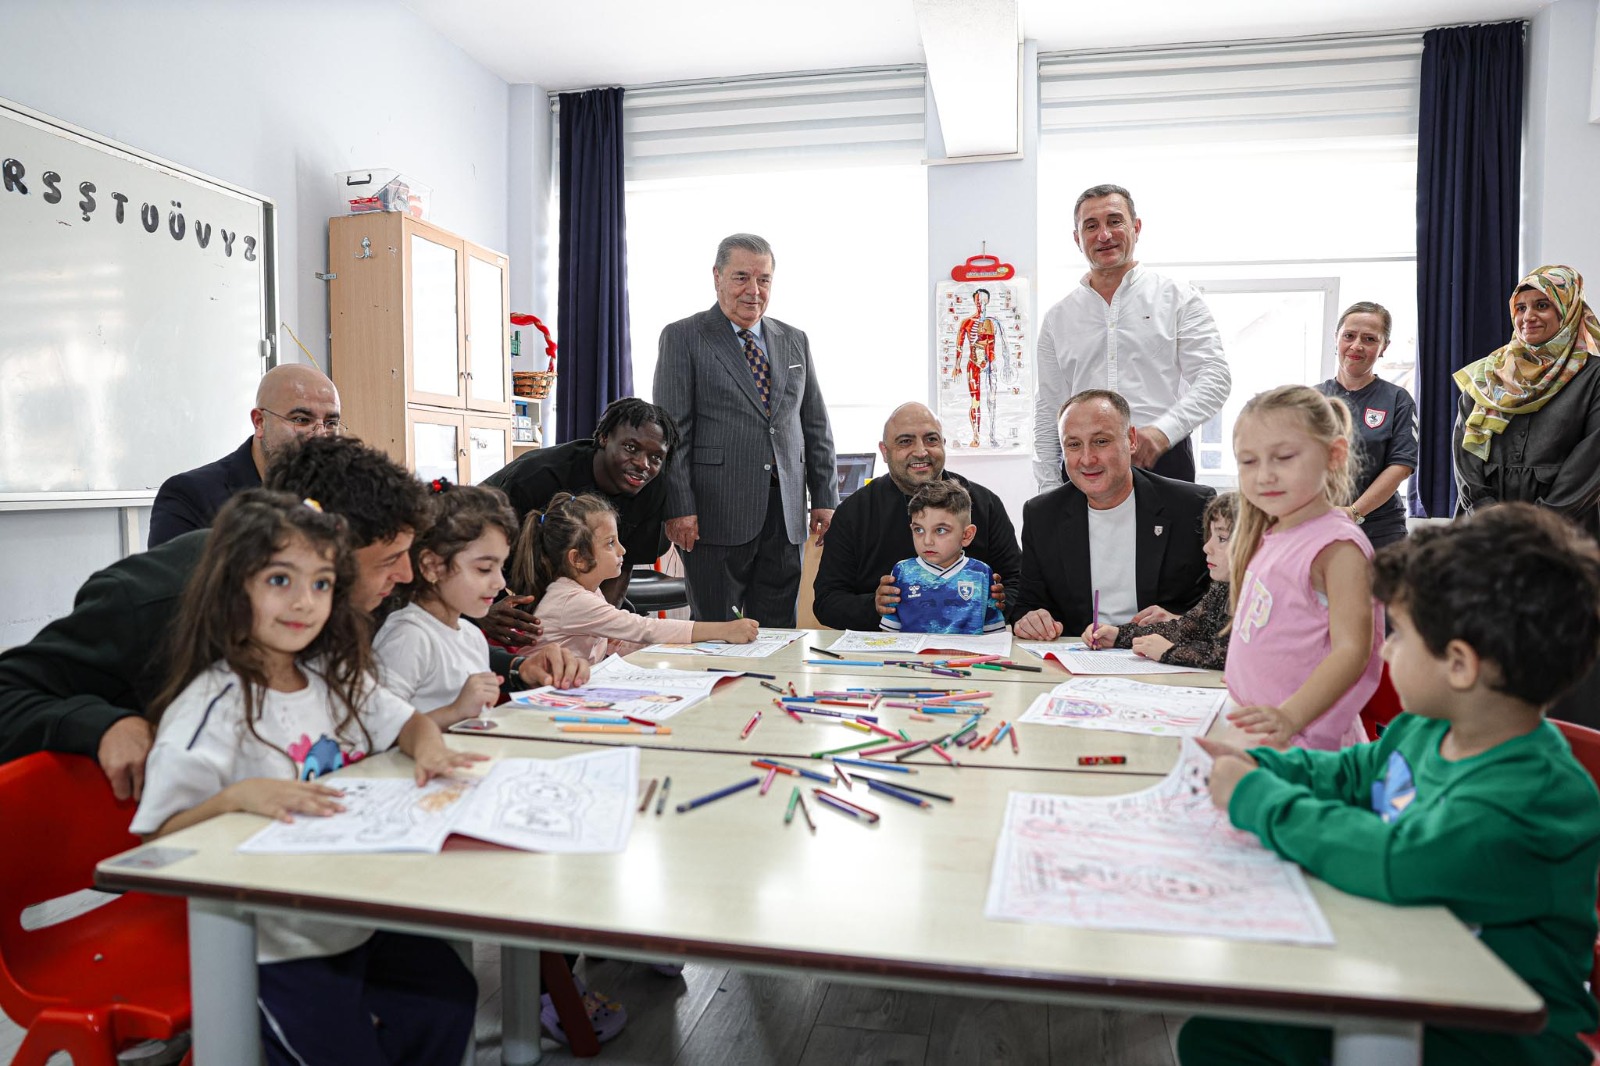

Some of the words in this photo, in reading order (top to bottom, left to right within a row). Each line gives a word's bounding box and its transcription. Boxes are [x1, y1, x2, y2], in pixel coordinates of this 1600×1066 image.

[2, 158, 28, 195] R
[42, 171, 62, 204] S
[79, 181, 97, 222] Ş
[111, 191, 129, 224] T
[141, 202, 159, 233] U
[169, 200, 186, 241] Ü
[195, 219, 212, 249] V
[220, 228, 236, 258] Y
[244, 235, 257, 262] Z
